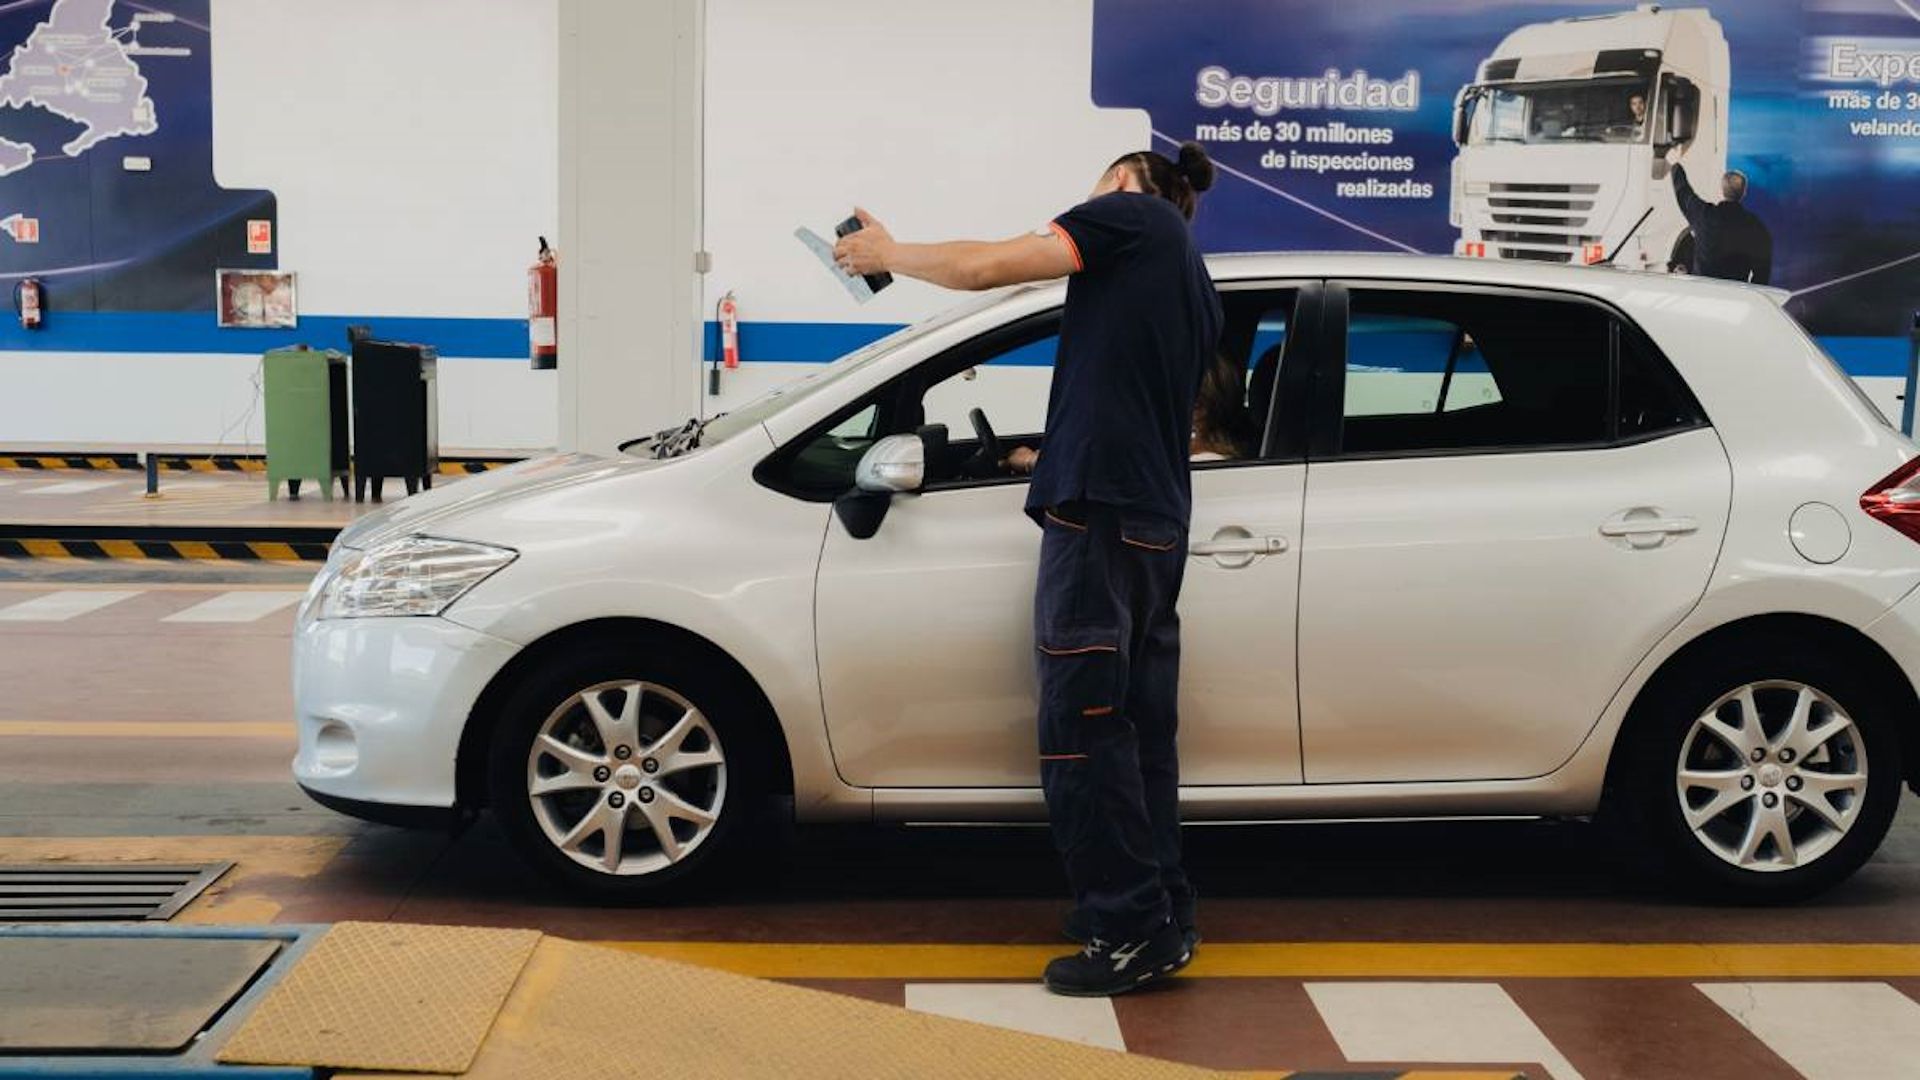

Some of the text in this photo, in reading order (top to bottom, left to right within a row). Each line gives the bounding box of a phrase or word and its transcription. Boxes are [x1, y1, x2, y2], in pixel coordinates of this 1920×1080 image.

[1196, 65, 1420, 116] Seguridad
[1828, 90, 1920, 110] más de 3
[1196, 120, 1393, 144] más de 30 millones
[1260, 150, 1415, 173] de inspecciones
[1336, 179, 1433, 198] realizadas
